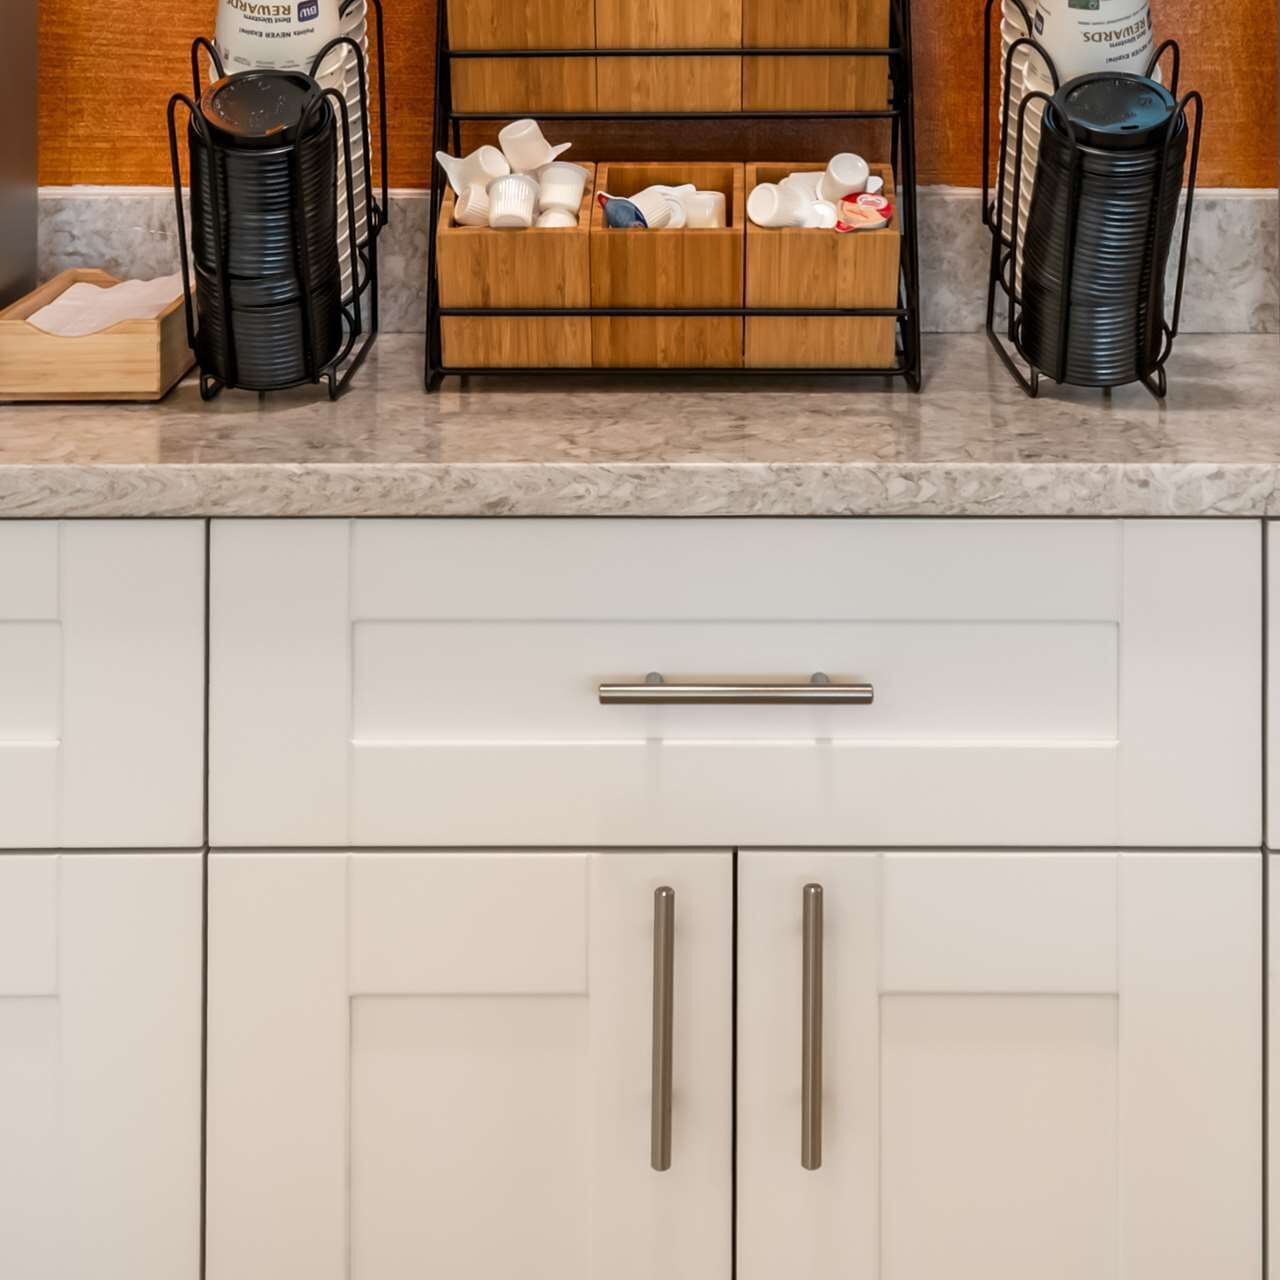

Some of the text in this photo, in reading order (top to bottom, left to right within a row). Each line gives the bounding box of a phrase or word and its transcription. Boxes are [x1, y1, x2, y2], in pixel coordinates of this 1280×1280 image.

[275, 16, 292, 24] Best
[1083, 17, 1146, 43] REWARDS
[265, 31, 291, 39] NEVER
